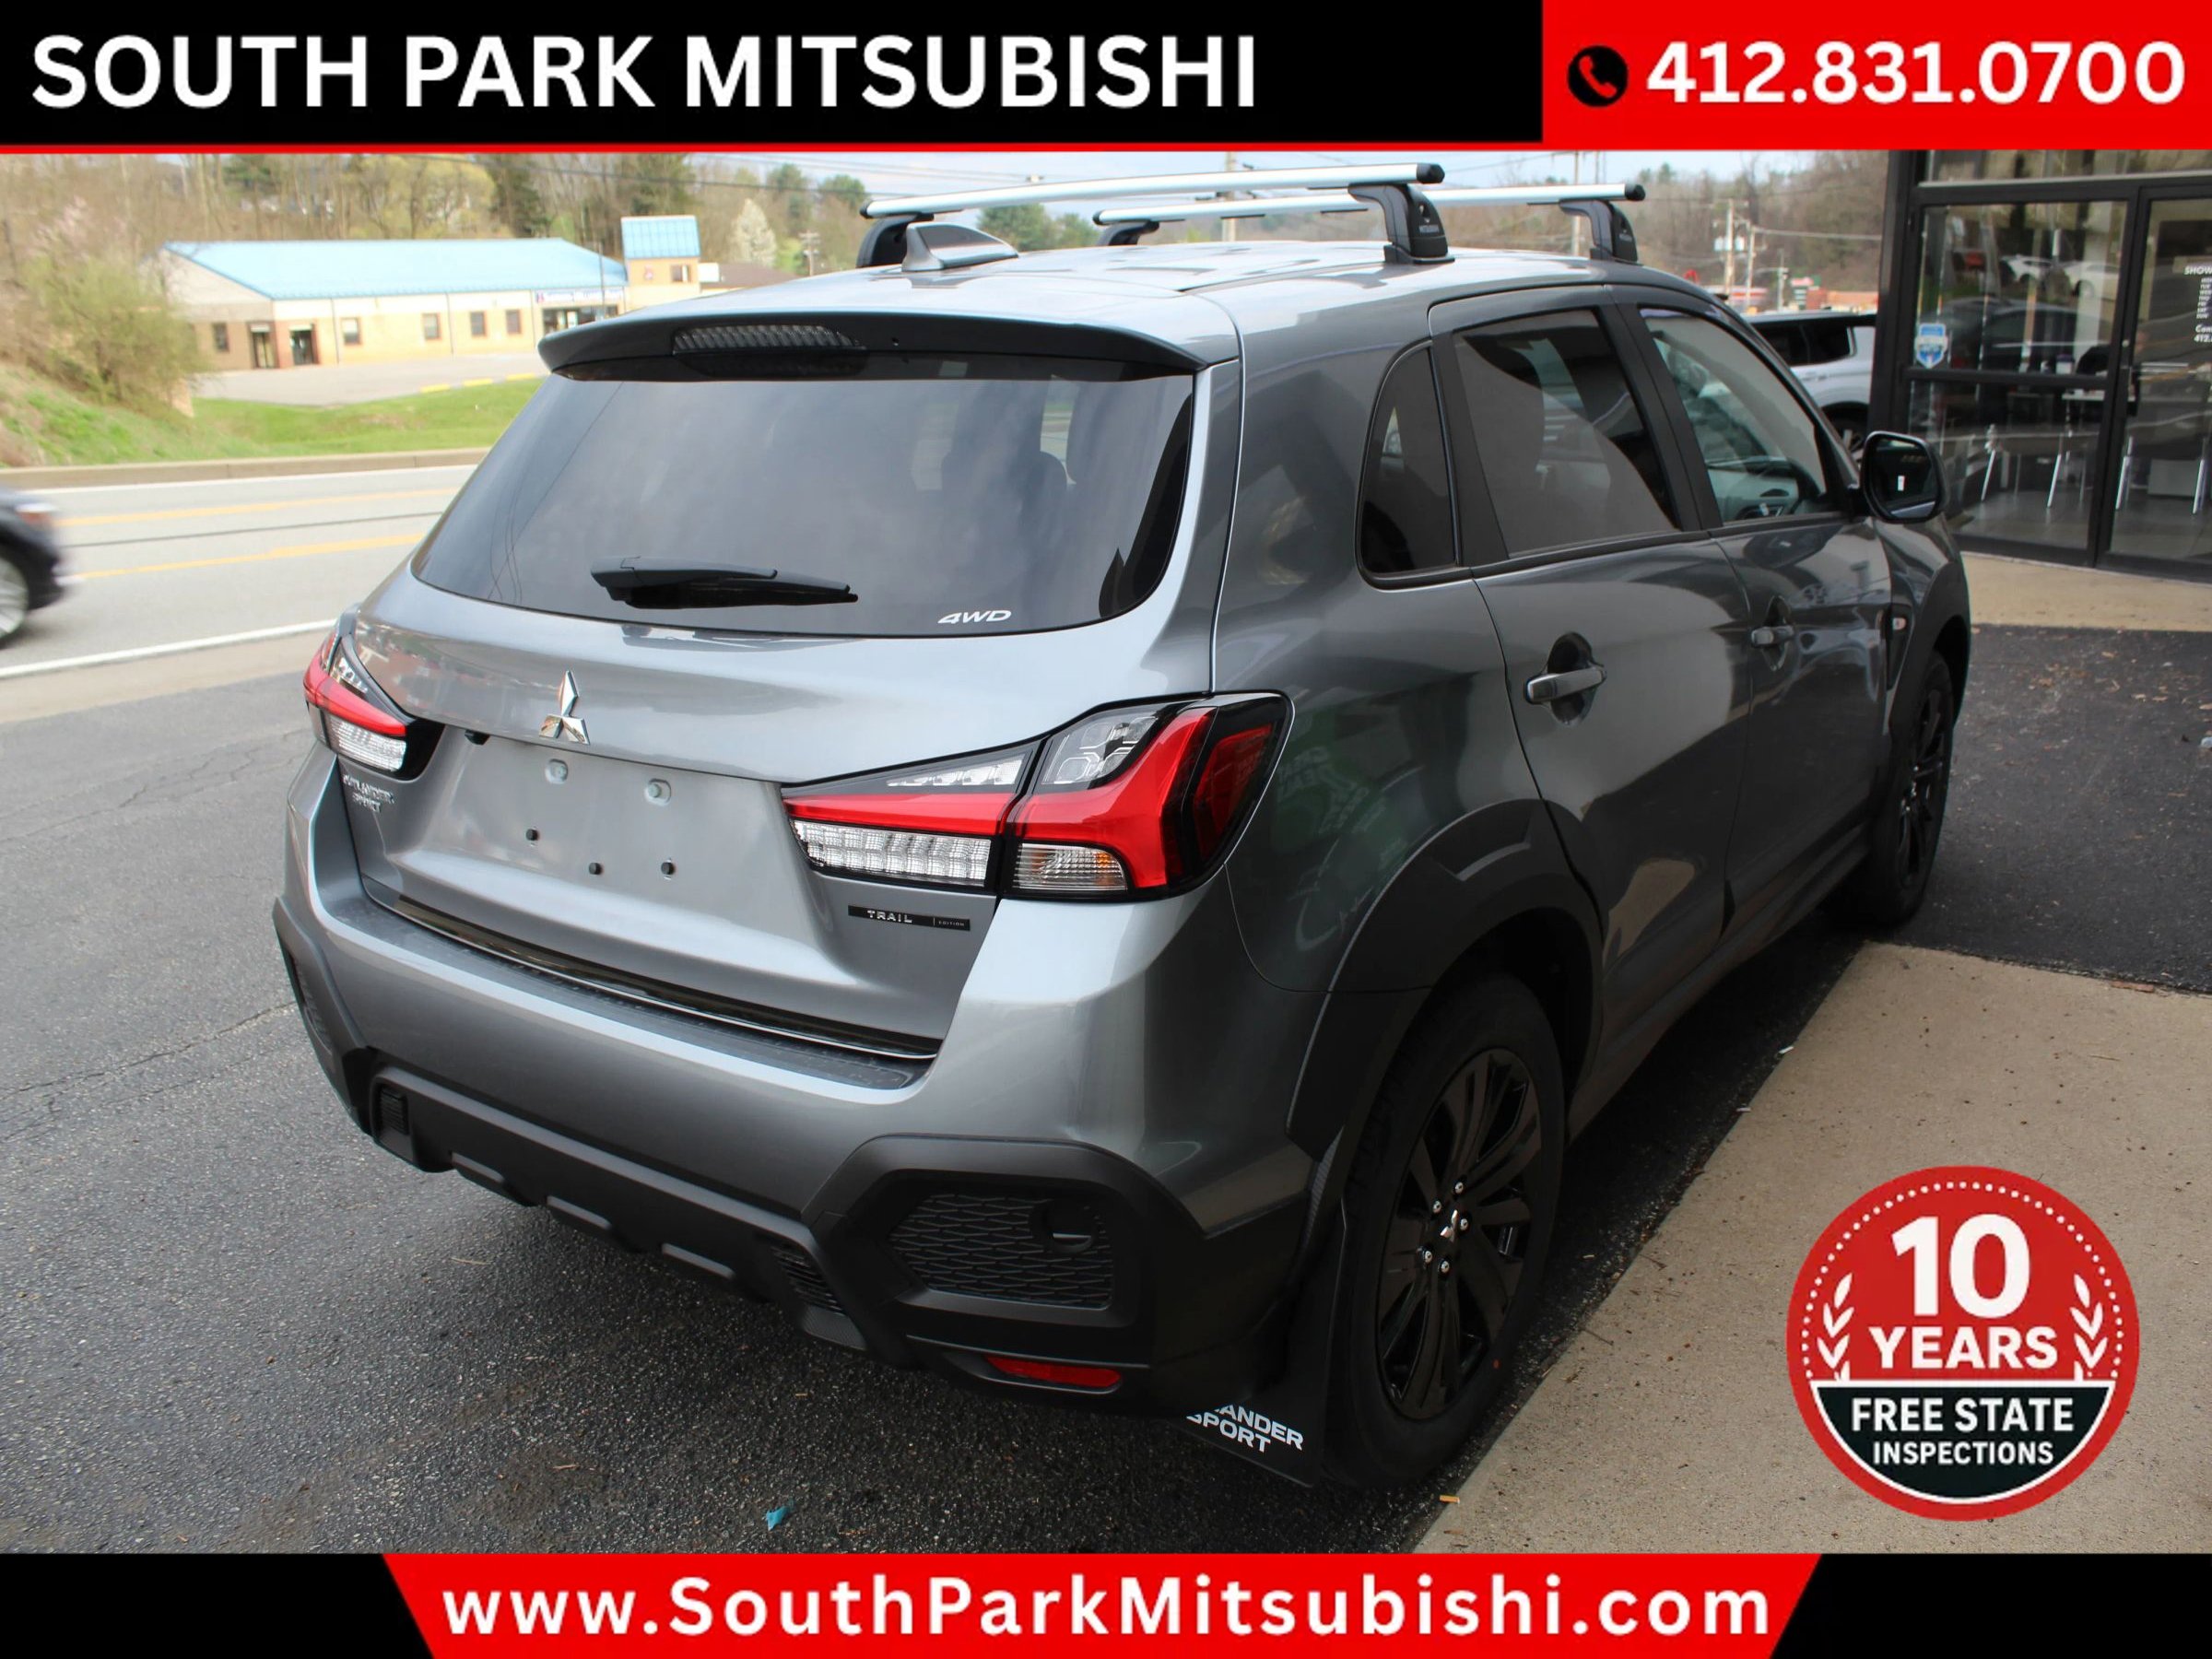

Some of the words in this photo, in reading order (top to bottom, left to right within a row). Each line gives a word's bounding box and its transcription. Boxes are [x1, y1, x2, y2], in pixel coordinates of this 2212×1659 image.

[937, 609, 1012, 625] 4WD
[866, 910, 912, 924] TRAIL
[1214, 1404, 1304, 1451] ANDER
